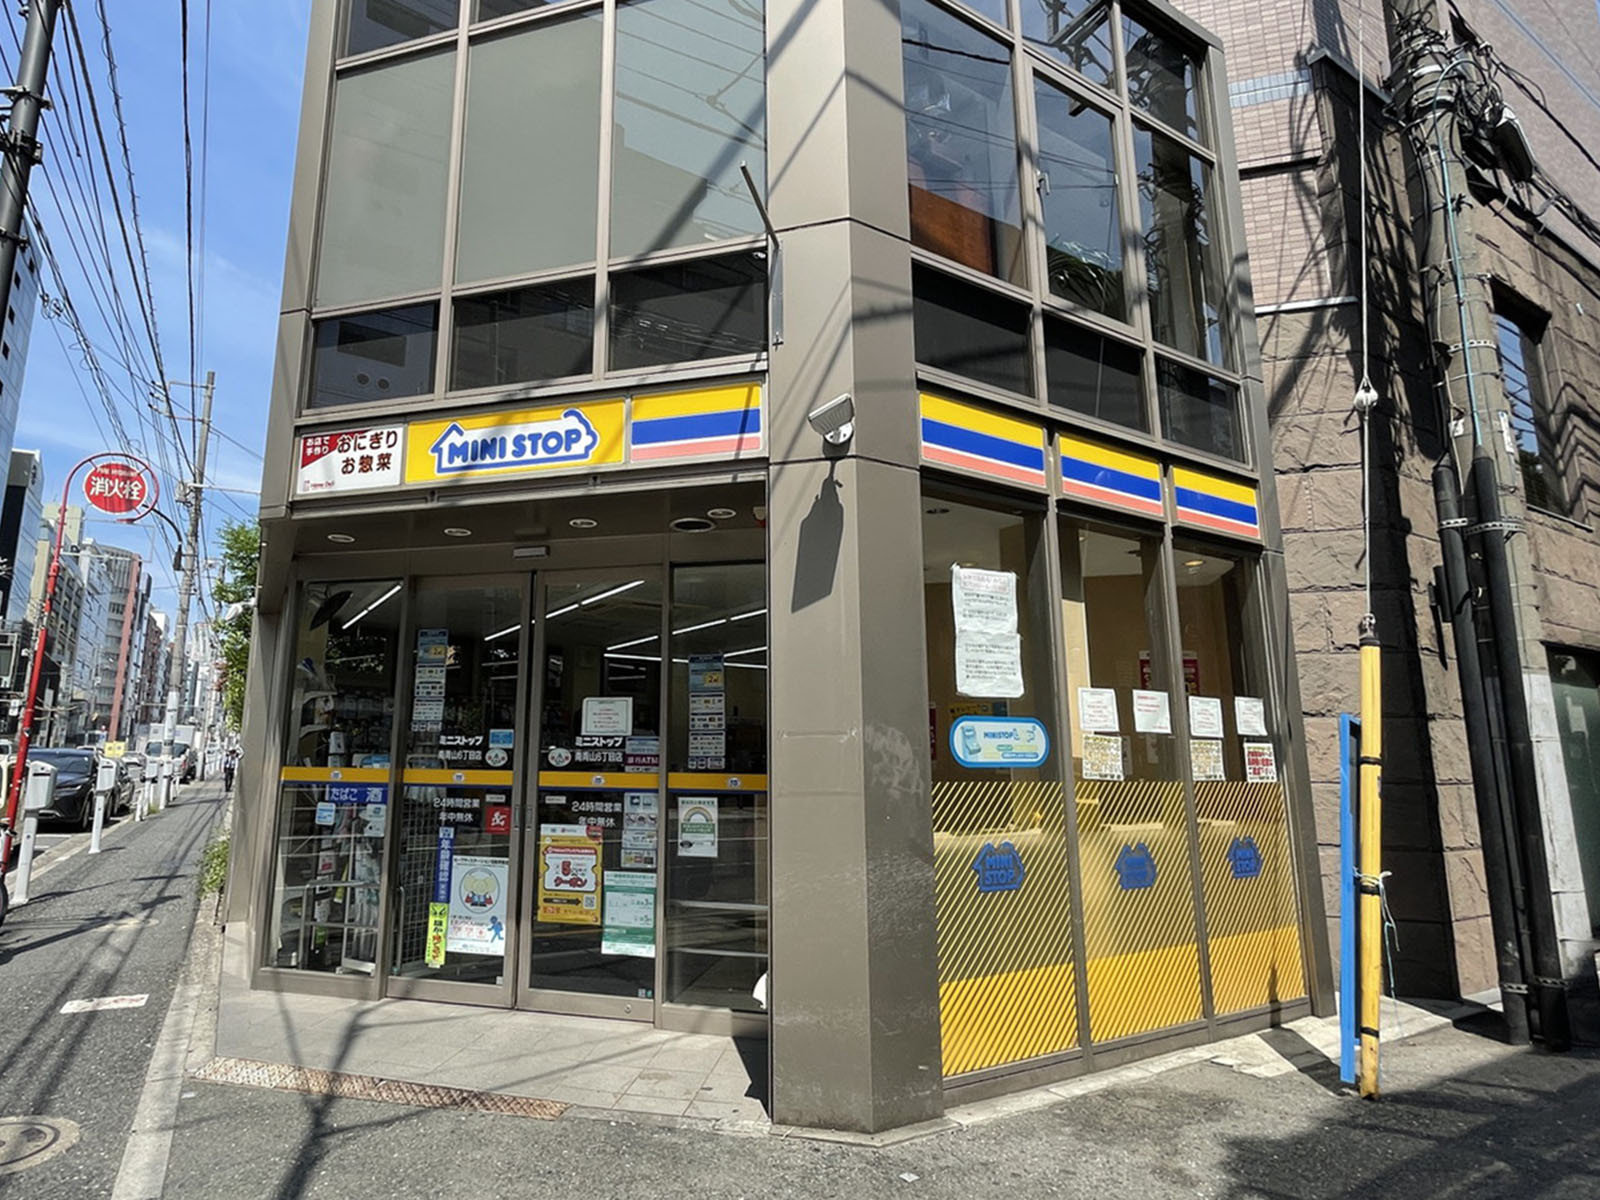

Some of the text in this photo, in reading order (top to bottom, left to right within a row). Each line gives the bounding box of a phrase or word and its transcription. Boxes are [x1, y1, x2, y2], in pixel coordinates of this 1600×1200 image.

[337, 430, 398, 453] おにぎり
[448, 428, 582, 464] MINI STOP
[341, 452, 392, 475] お惣菜
[90, 476, 142, 500] 消火栓
[439, 735, 483, 747] ミニストップ
[575, 736, 623, 748] ミニストップ
[331, 787, 384, 802] たばこ 酒
[571, 801, 622, 813] 24時間営業
[985, 869, 1014, 884] STOP
